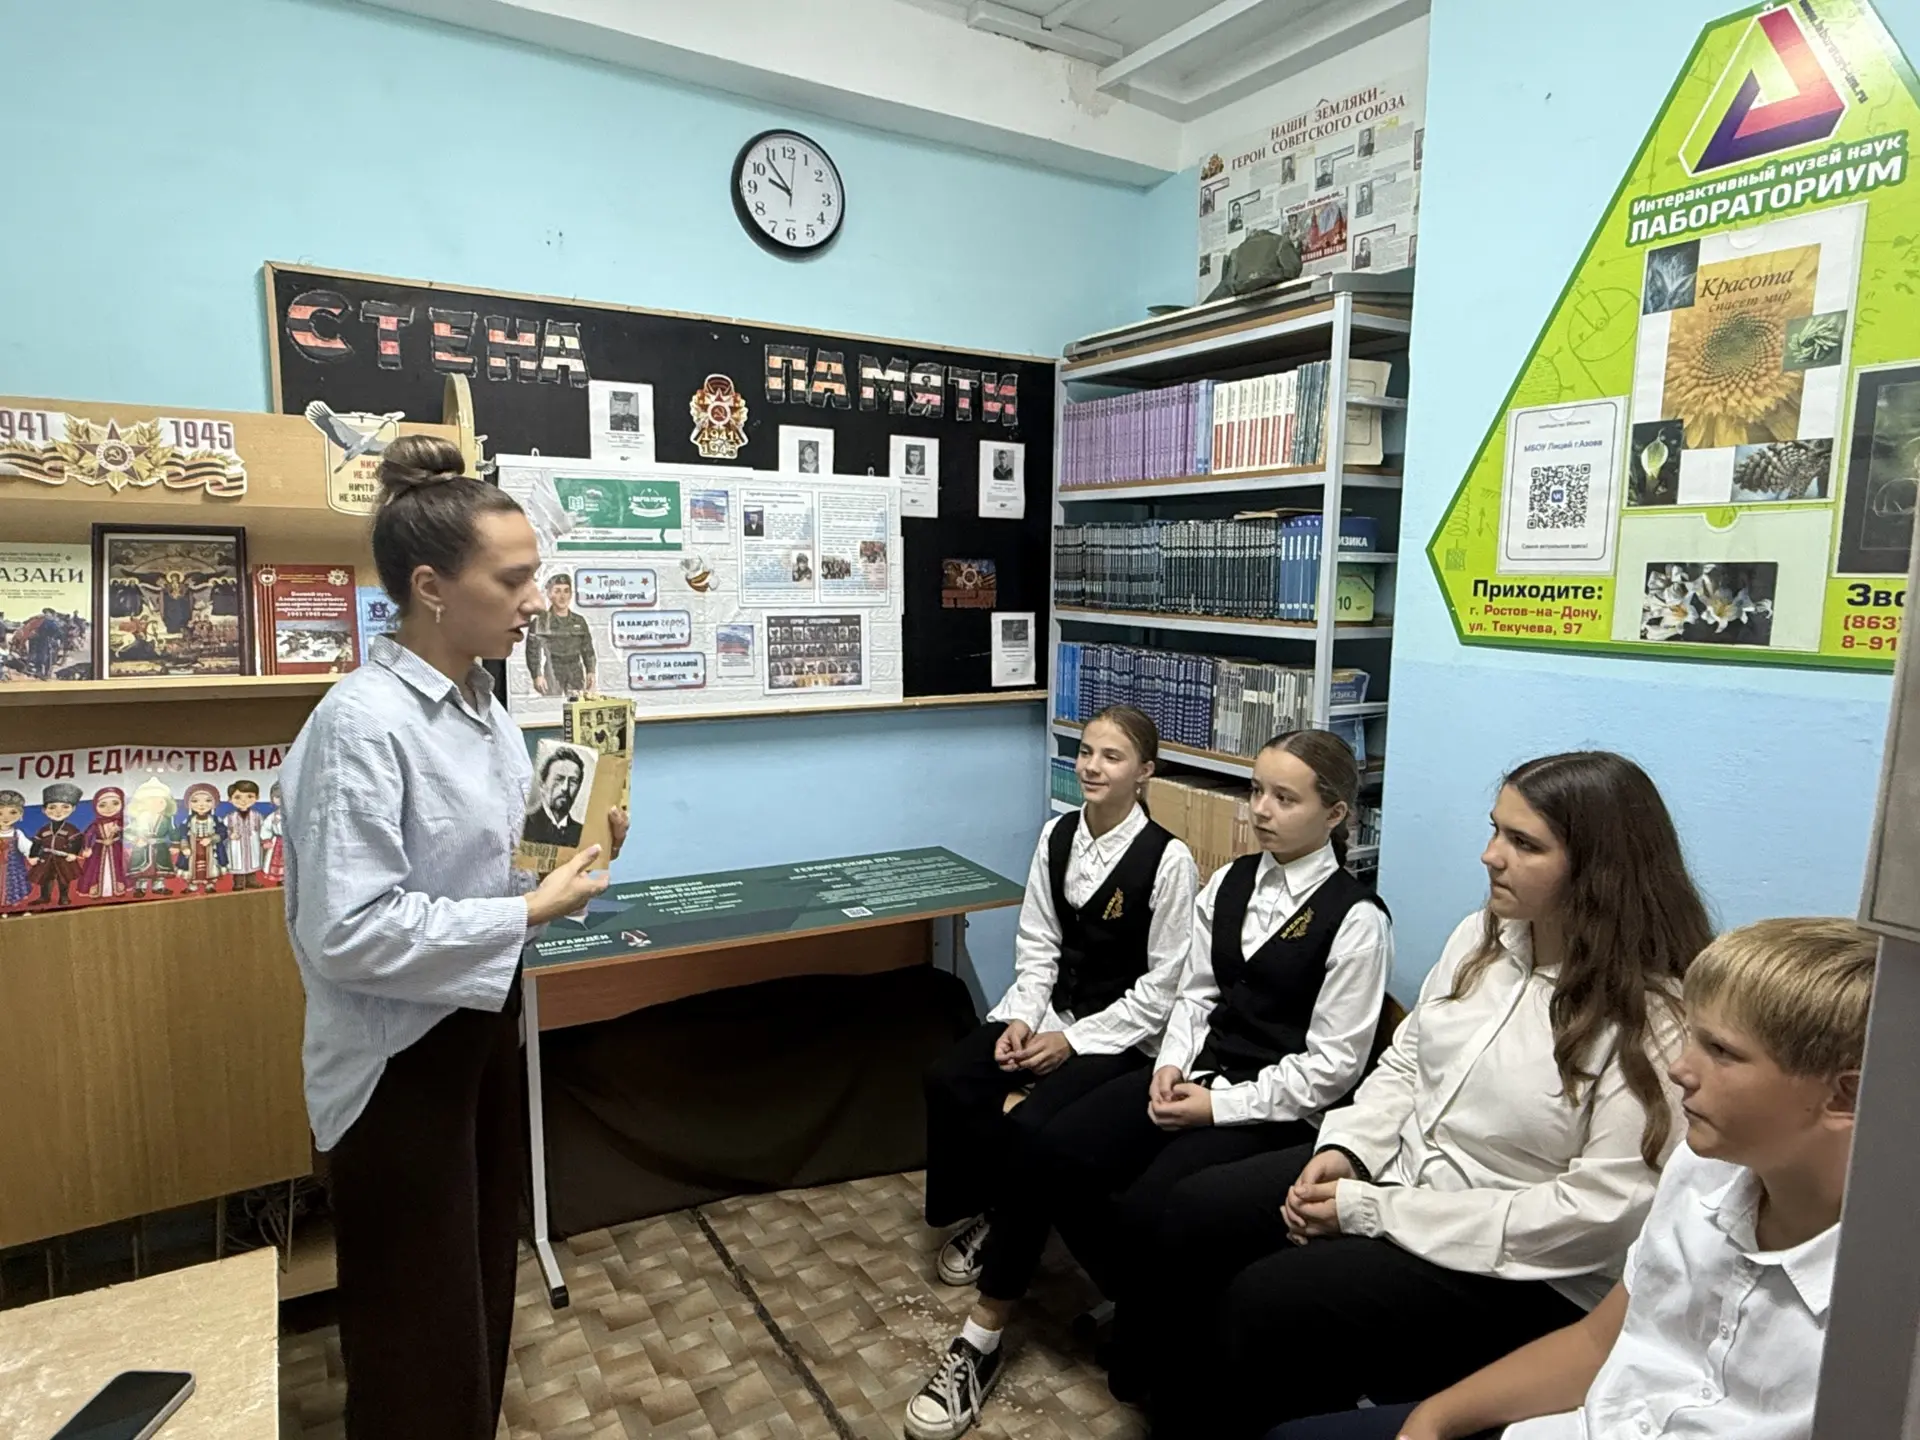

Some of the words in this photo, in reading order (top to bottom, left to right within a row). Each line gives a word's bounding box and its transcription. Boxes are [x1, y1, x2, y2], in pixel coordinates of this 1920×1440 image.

[1271, 115, 1307, 141] НАШИ
[1314, 87, 1378, 122] ЗЕМЛЯКИ
[1232, 147, 1266, 171] ГЕРОИ
[1272, 116, 1351, 154] СОВЕТСКОГО
[1355, 94, 1406, 124] СОЮЗА
[782, 146, 796, 160] 12
[803, 154, 809, 166] 1
[752, 162, 766, 176] 10
[814, 169, 823, 183] 2
[1633, 166, 1775, 214] Интерактивный
[1781, 149, 1842, 177] музей
[1847, 134, 1901, 160] наук
[747, 180, 758, 194] 9
[821, 193, 832, 207] 3
[1629, 155, 1901, 244] ЛАБОРАТОРИУМ
[755, 201, 766, 216] 8
[817, 212, 826, 225] 4
[768, 221, 778, 234] 7
[786, 226, 797, 241] 6
[806, 224, 815, 238] 5
[1700, 269, 1795, 300] Красота
[1708, 297, 1759, 312] спасет
[1761, 290, 1792, 304] мир
[285, 289, 591, 388] СТЕНА
[764, 344, 1019, 427] ПАМЯТИ
[0, 410, 50, 441] 941
[170, 420, 233, 449] 1945
[702, 430, 736, 441] 1941
[702, 443, 736, 456] 1945
[1339, 536, 1369, 547] ИЗИКА
[0, 567, 84, 583] АЗАКИ
[1473, 580, 1603, 602] Приходите:
[1338, 596, 1352, 610] 10
[1470, 606, 1479, 616] г.
[1484, 605, 1602, 621] Ростов-на-Дону,
[1468, 621, 1486, 633] ул.
[1492, 620, 1557, 636] Текучева,
[1563, 622, 1582, 635] 97
[1842, 635, 1897, 651] 8-91
[88, 748, 237, 774] ЕДИНСТВА
[249, 747, 291, 771] НА
